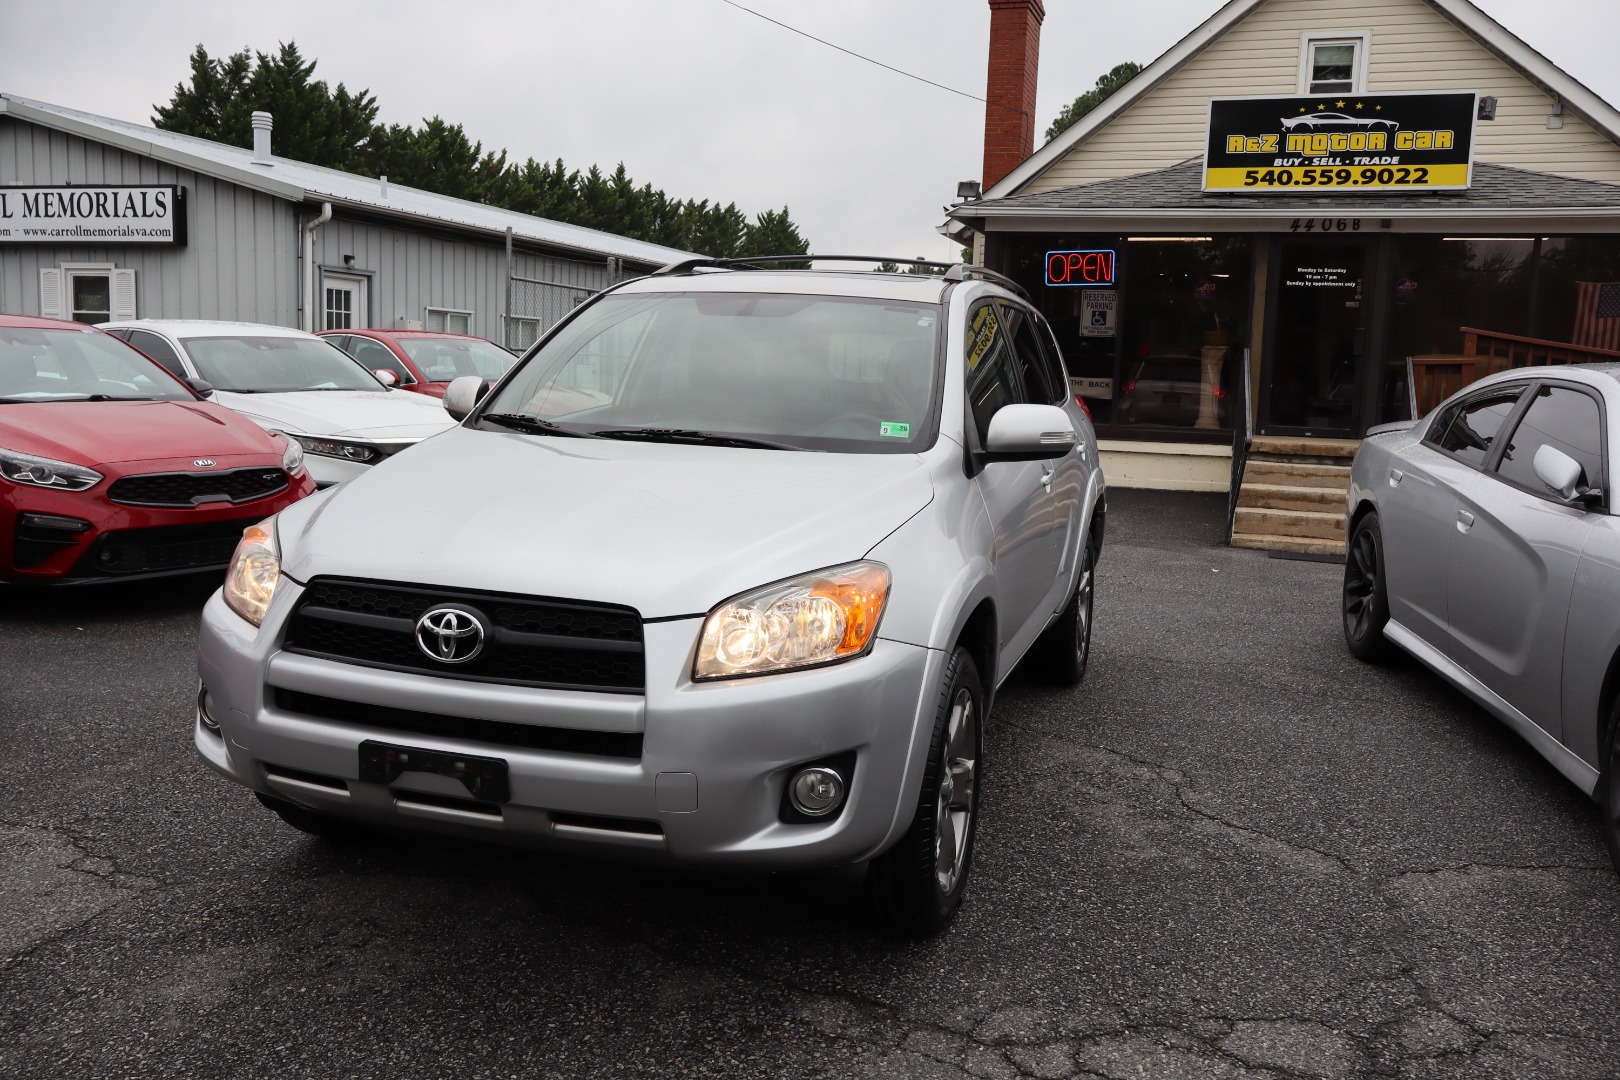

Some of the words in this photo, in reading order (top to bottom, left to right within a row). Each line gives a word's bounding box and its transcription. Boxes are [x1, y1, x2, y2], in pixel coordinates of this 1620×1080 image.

[1273, 158, 1303, 167] BUY
[1311, 157, 1342, 166] SELL
[1353, 156, 1400, 165] TRADE
[1244, 167, 1429, 186] 540.559.9022
[22, 191, 167, 218] MEMORIALS
[23, 225, 171, 237] www.carrollmemorialsva.com
[1049, 253, 1112, 282] OPEN
[1085, 293, 1116, 301] RESERVED
[1087, 302, 1113, 310] PARKING
